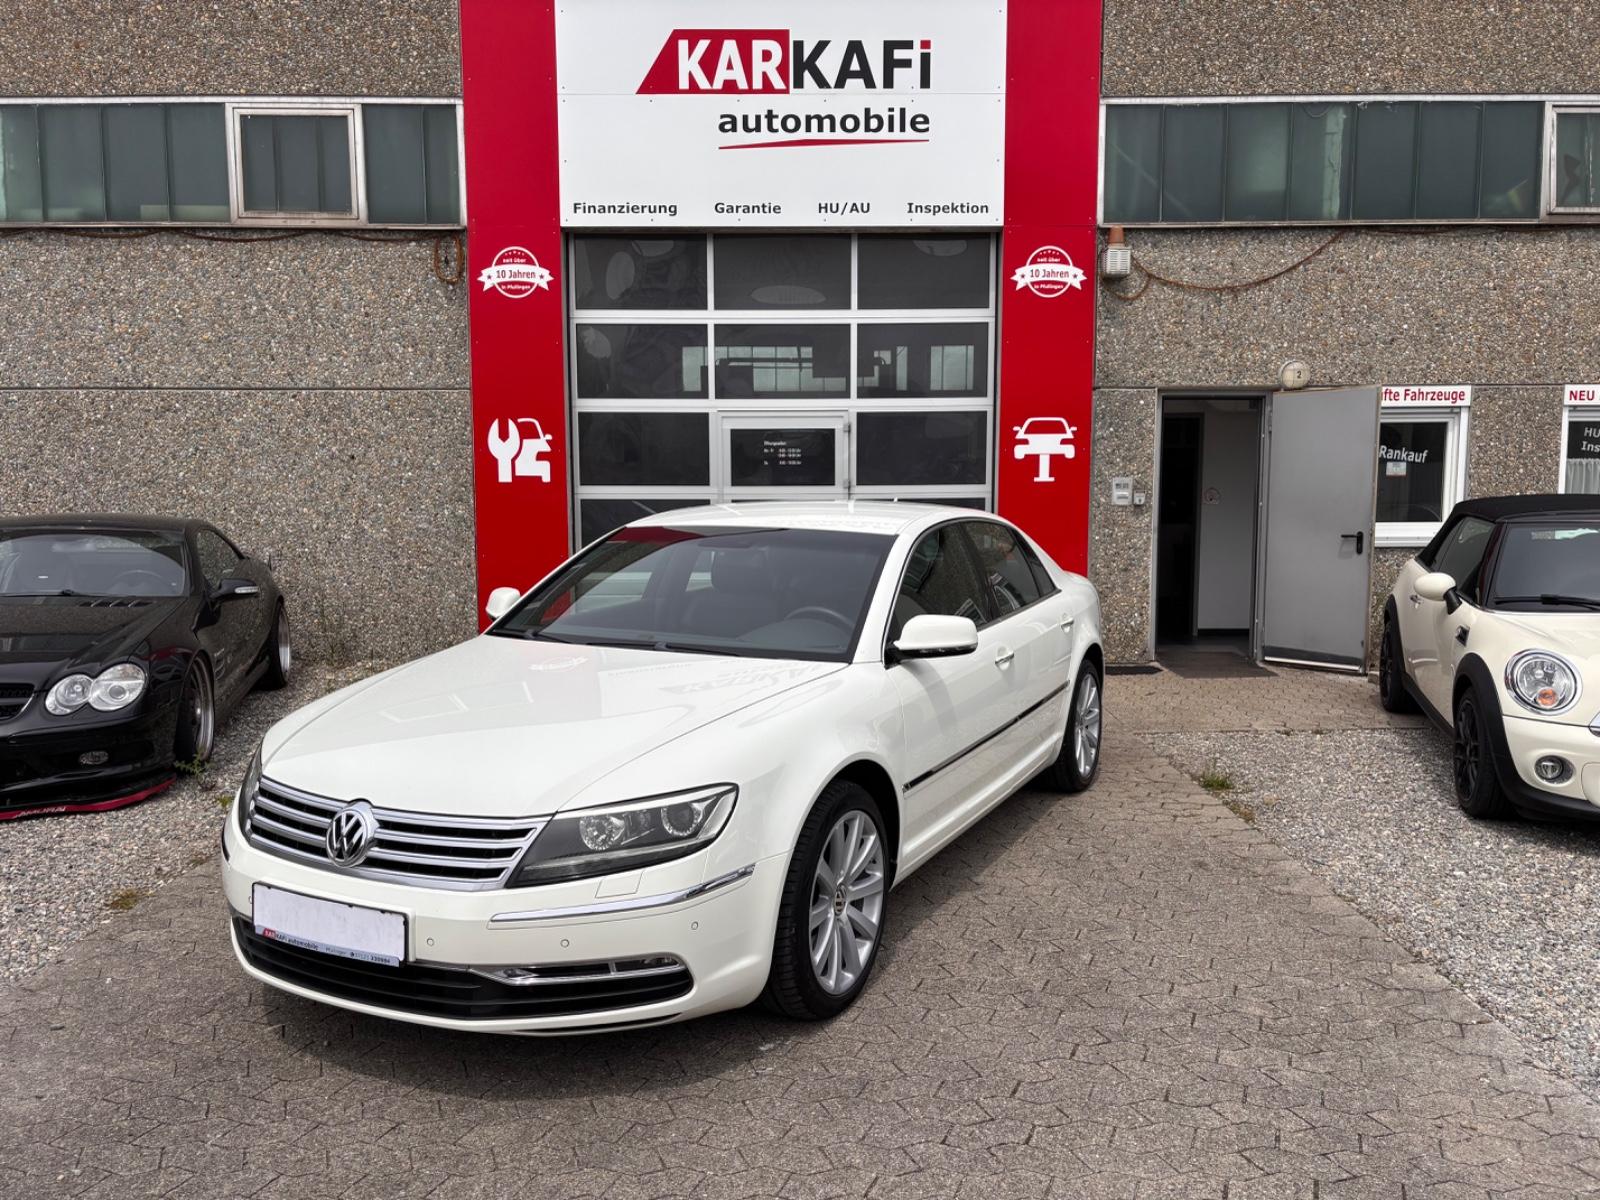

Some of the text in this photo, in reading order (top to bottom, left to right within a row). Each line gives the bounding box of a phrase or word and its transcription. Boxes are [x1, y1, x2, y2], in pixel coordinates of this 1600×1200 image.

[677, 39, 932, 90] KARKAFi
[718, 107, 931, 134] automobile
[573, 202, 990, 217] Finanzierung Garantie HU/AU Inspektion
[496, 269, 536, 279] 10 Jahren
[1030, 268, 1070, 279] 10 Jahren
[1382, 387, 1466, 404] fte Fahrzeuge
[1568, 389, 1596, 402] NEU
